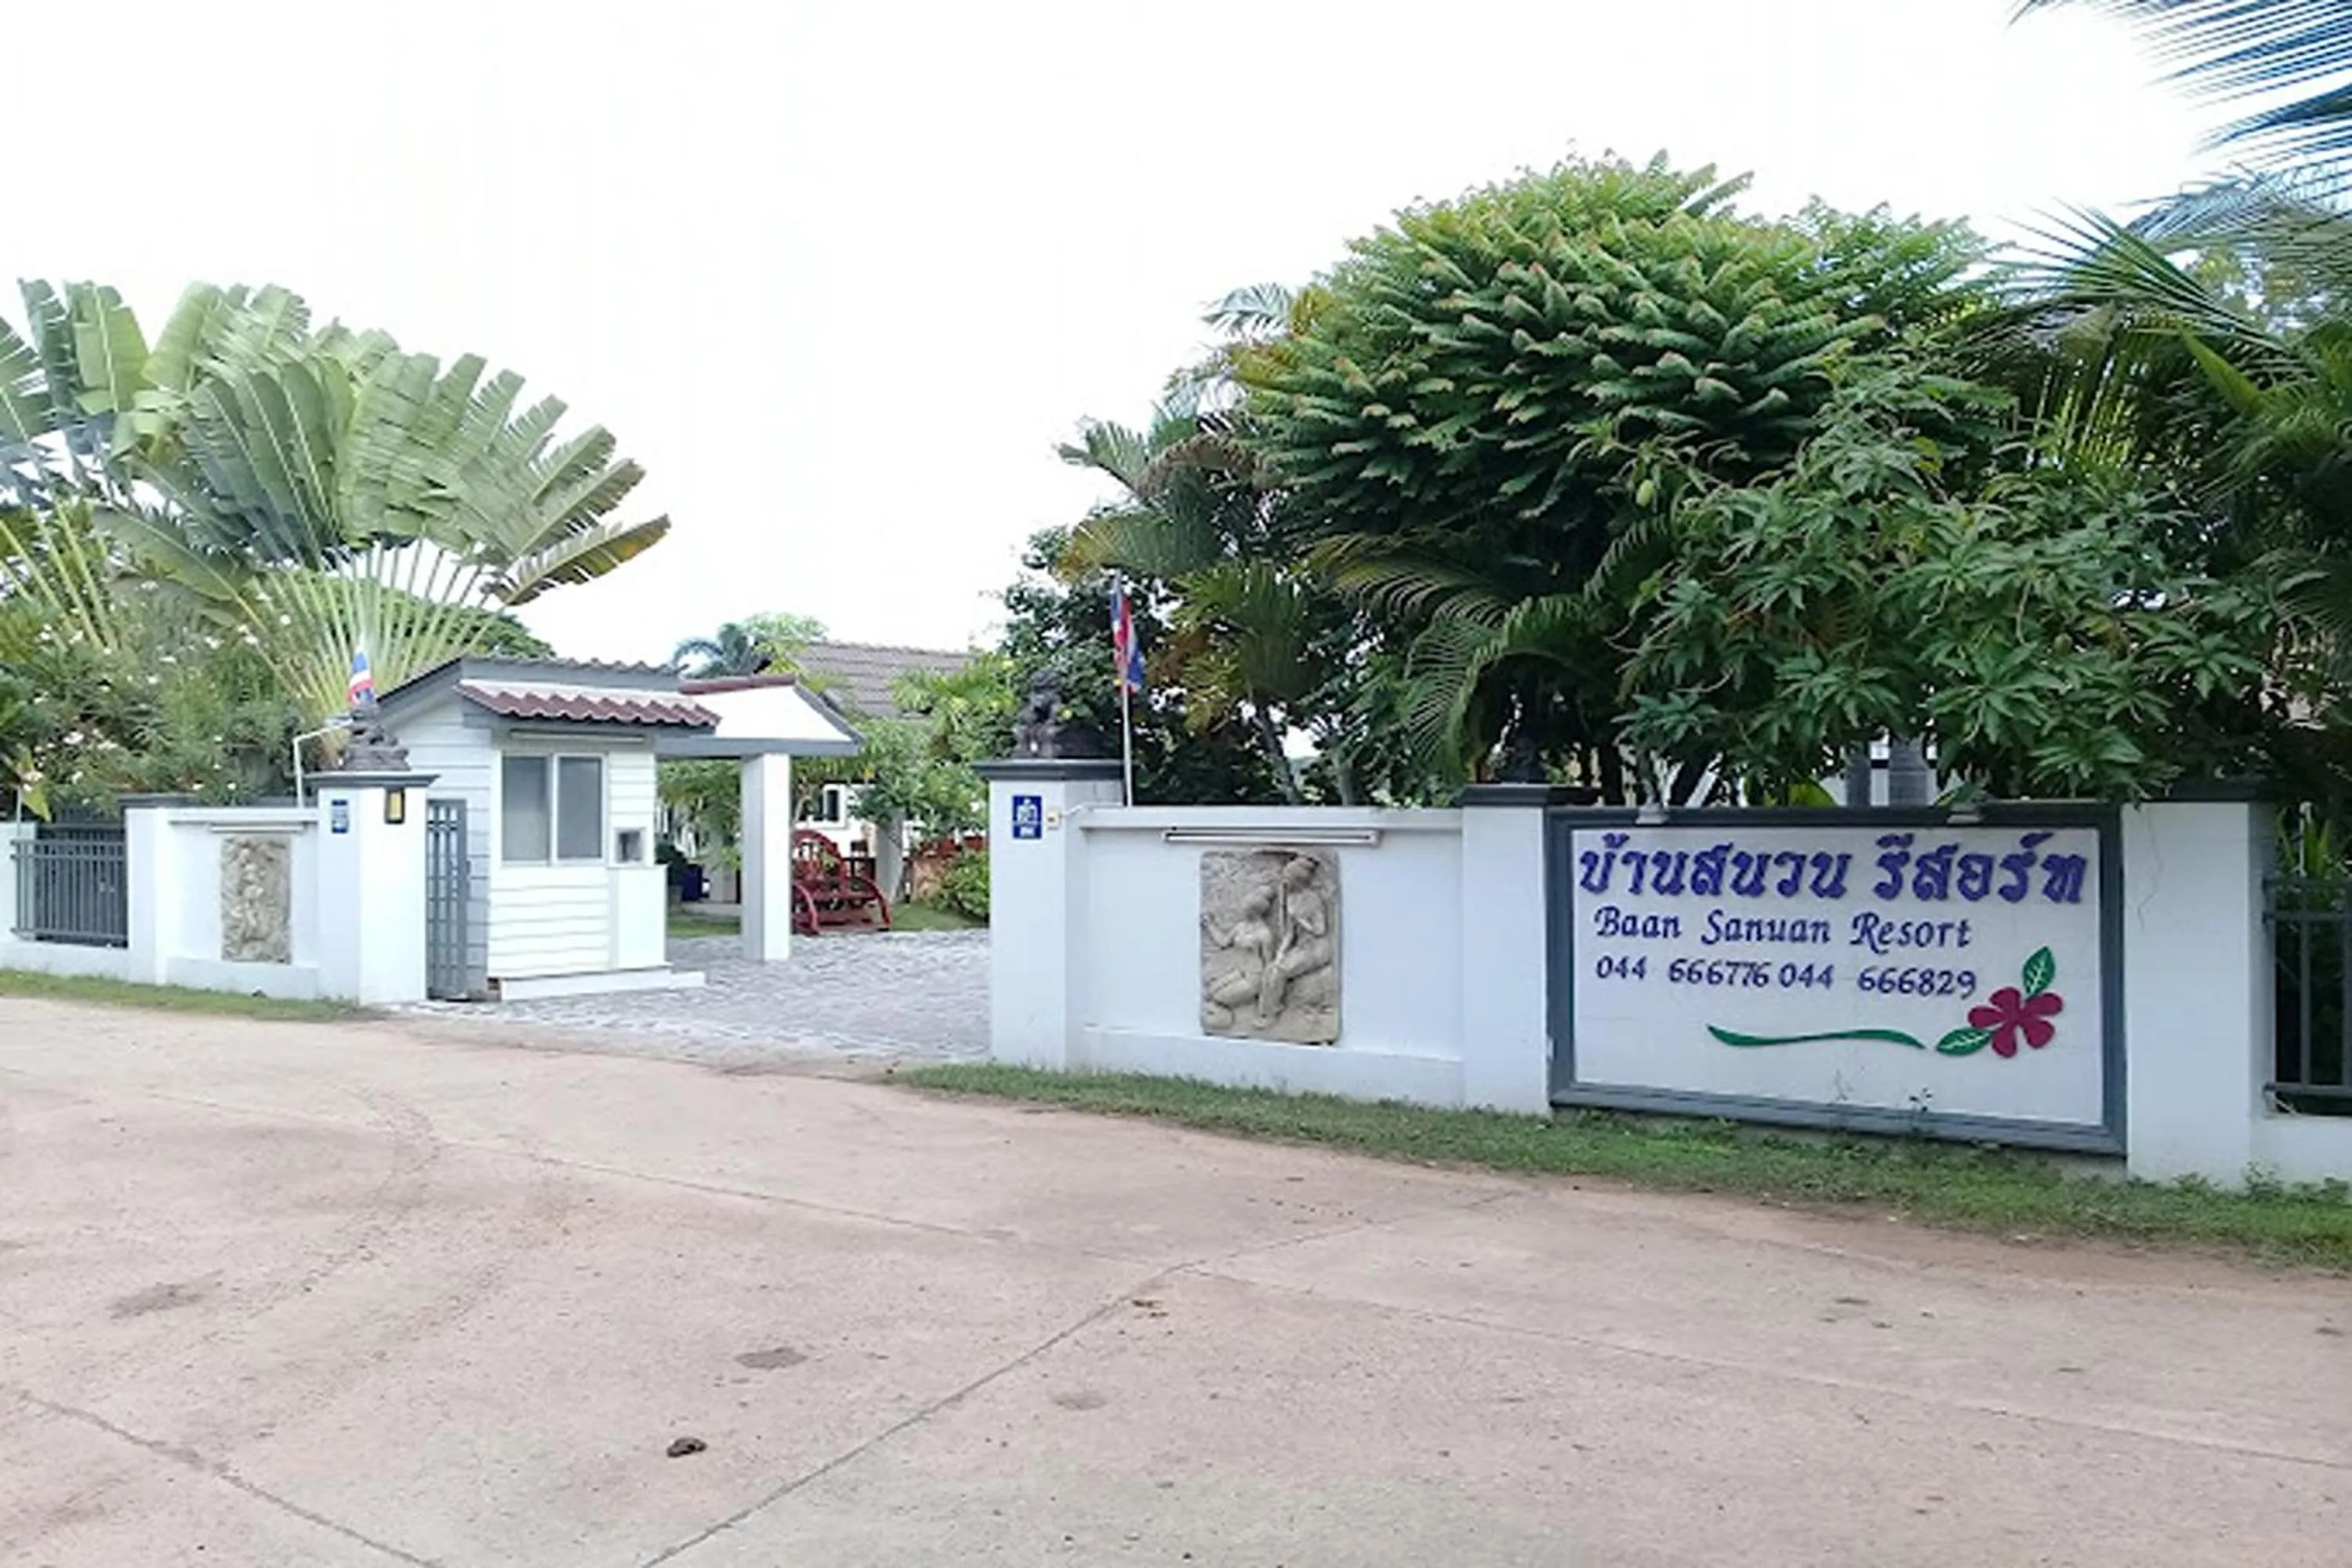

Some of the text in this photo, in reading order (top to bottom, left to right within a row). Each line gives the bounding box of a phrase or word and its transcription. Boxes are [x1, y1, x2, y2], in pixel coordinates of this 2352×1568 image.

[1579, 831, 2089, 904] บ้านสนวน รีสอร์ท
[1594, 906, 1971, 956] Baan Sanuan Resort
[1595, 954, 1977, 1001] 044 666776 044 666829
